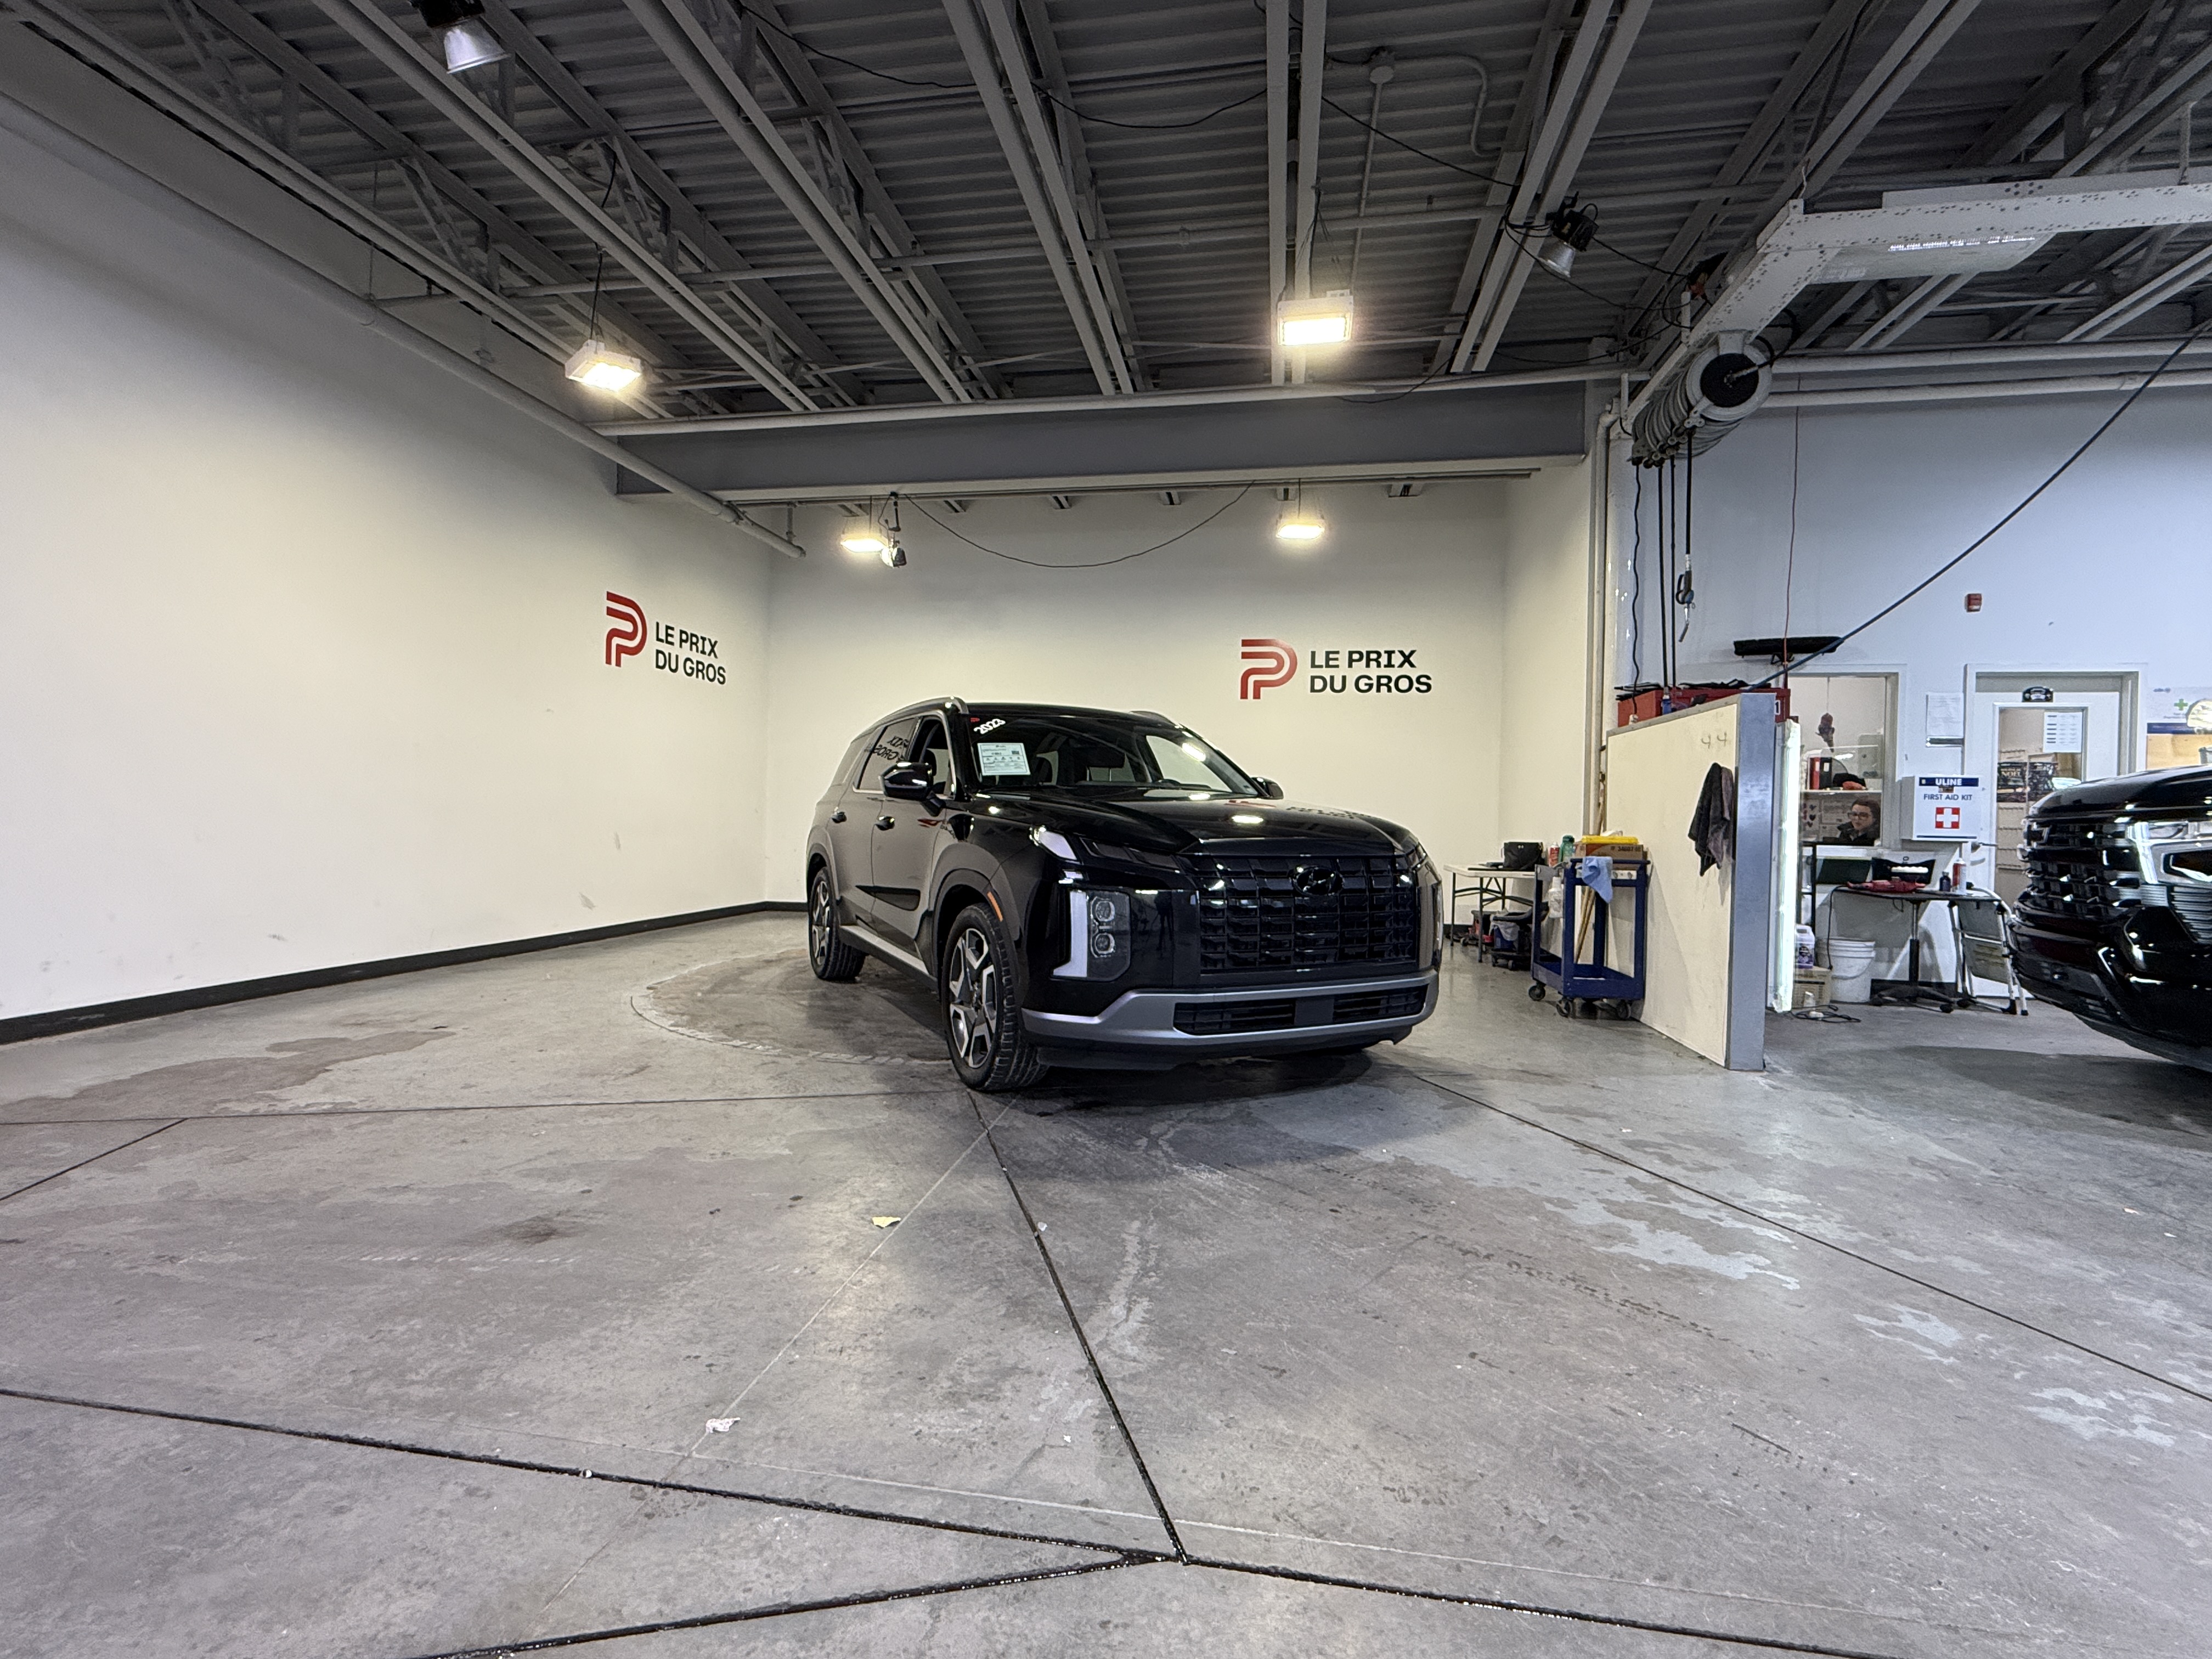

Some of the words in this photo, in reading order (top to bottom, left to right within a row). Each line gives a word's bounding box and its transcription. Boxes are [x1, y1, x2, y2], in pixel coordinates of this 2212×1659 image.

[656, 621, 675, 646] LE
[679, 629, 718, 659] PRIX
[655, 648, 679, 674] DU
[683, 657, 726, 685] GROS
[1310, 650, 1340, 669] LE
[1347, 650, 1417, 669] PRIX
[1310, 675, 1347, 693] DU
[1354, 674, 1432, 693] GROS
[973, 718, 1006, 734] 2023
